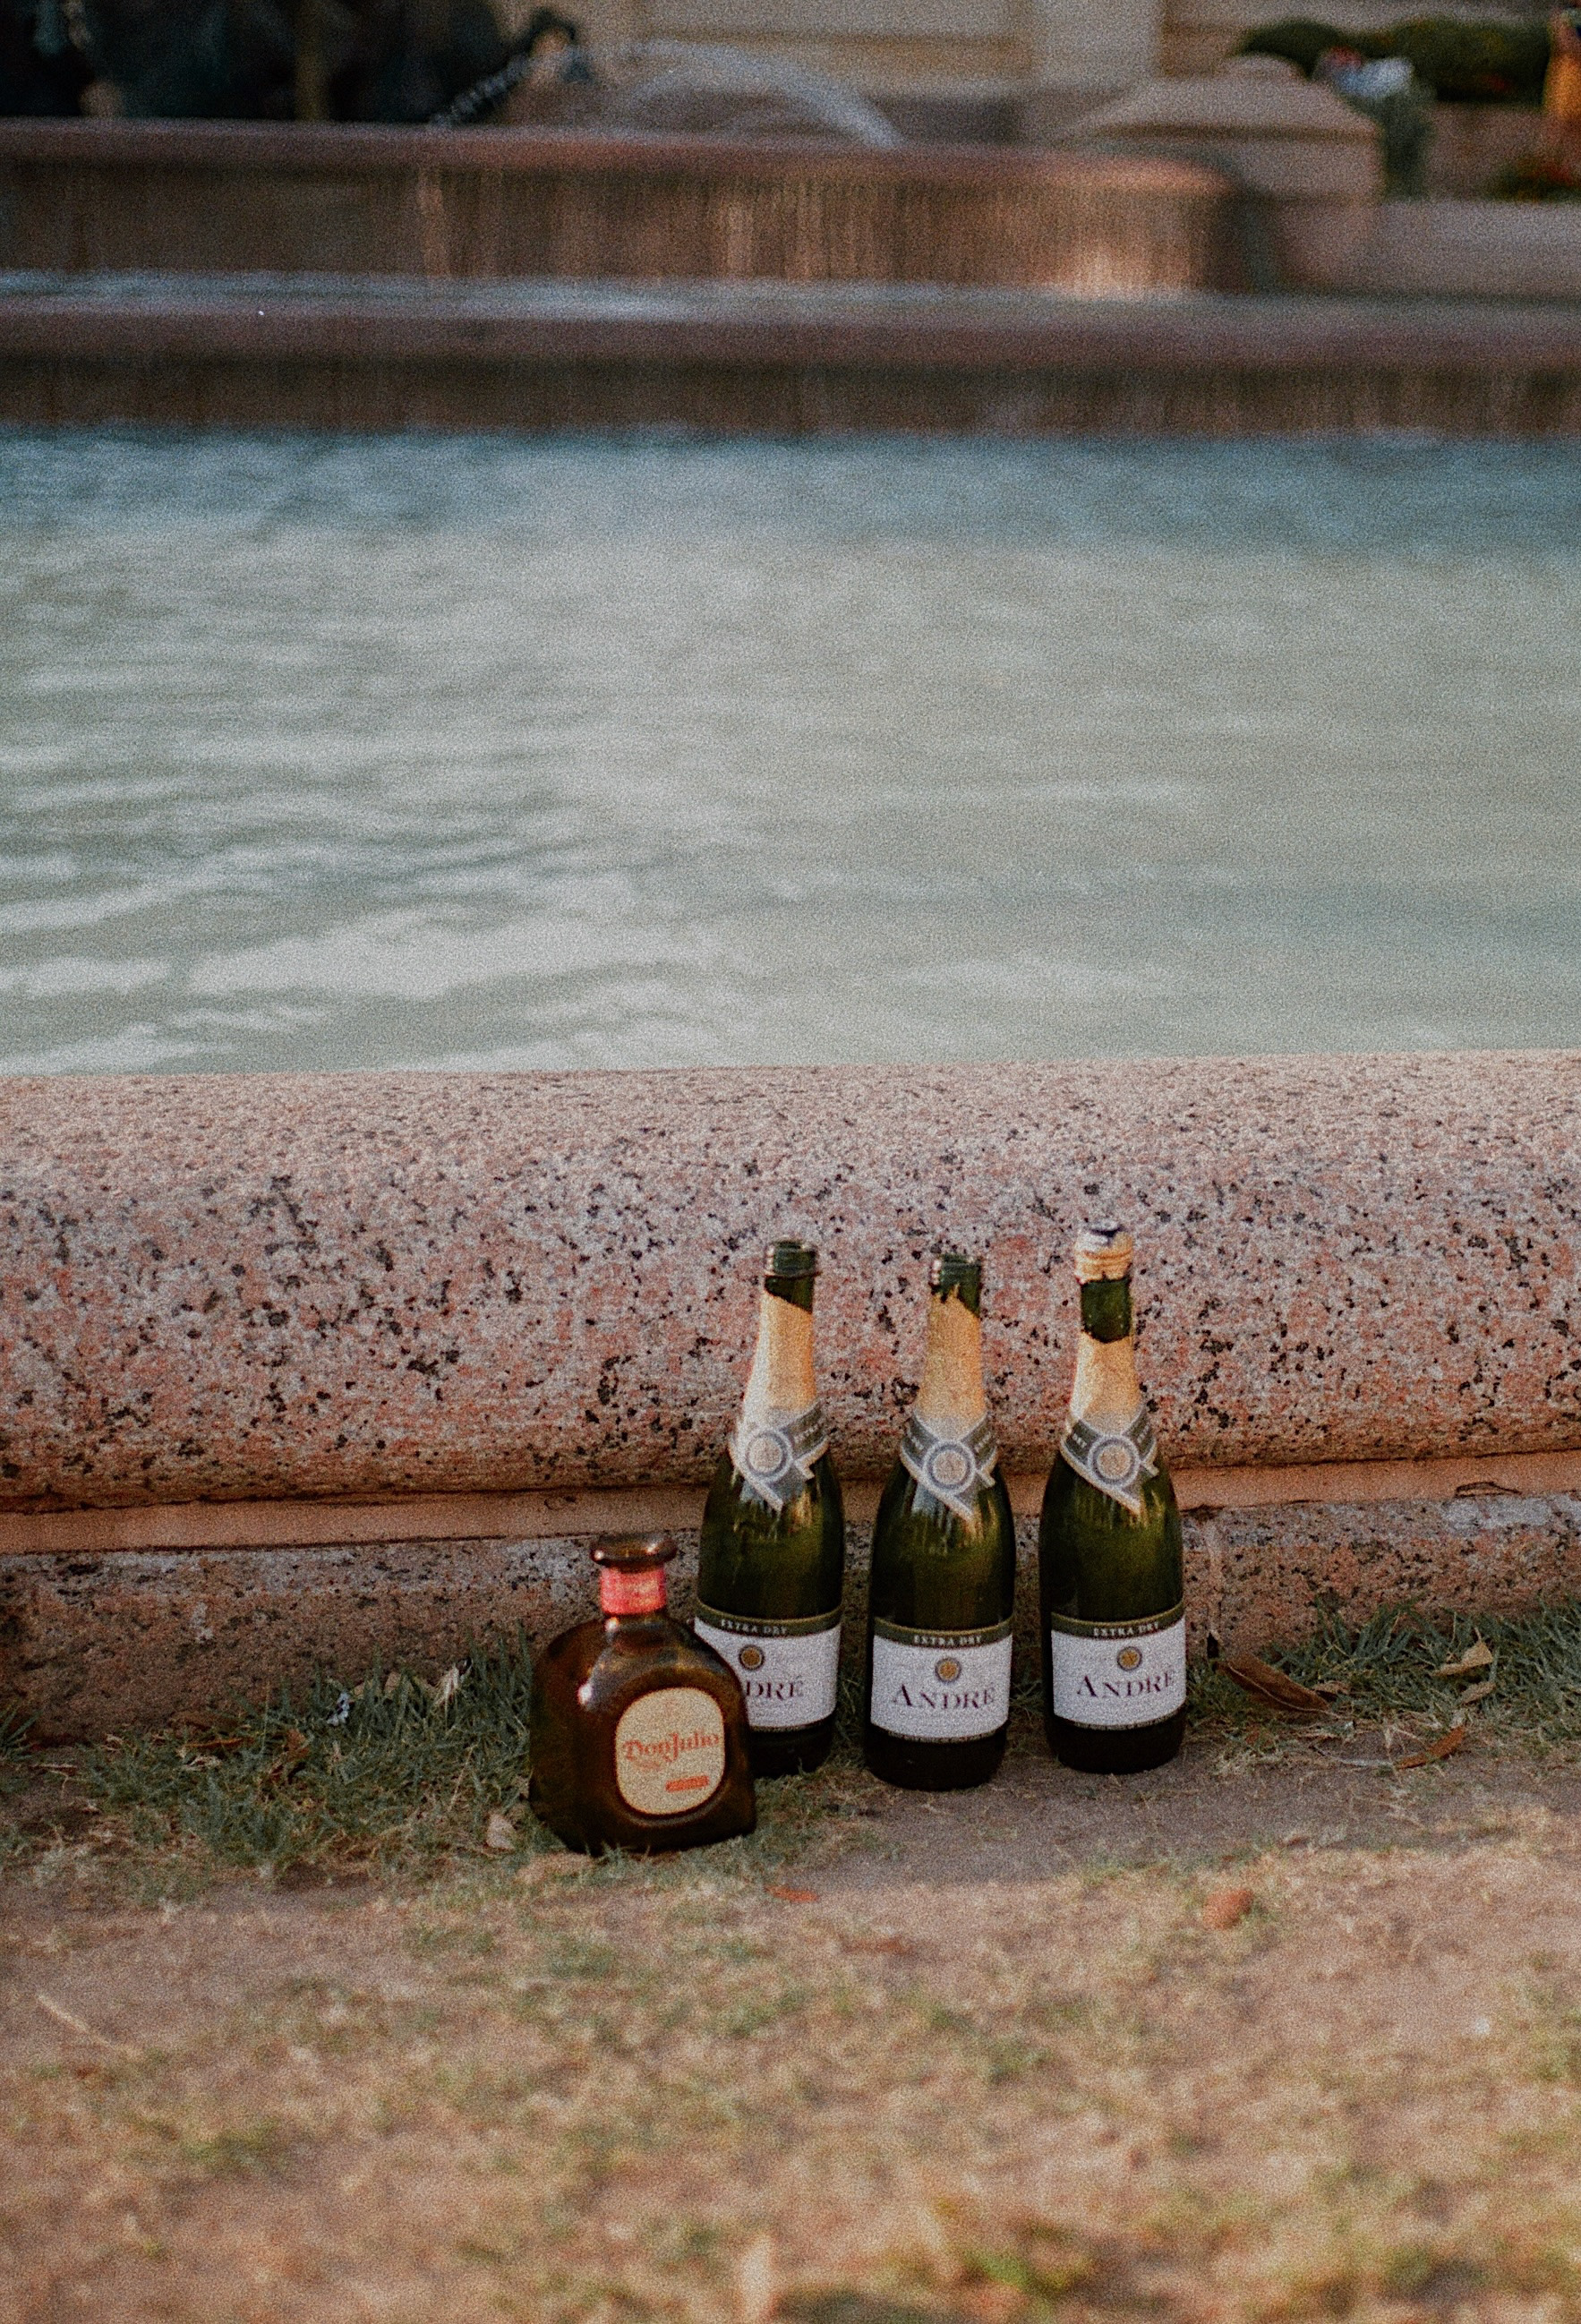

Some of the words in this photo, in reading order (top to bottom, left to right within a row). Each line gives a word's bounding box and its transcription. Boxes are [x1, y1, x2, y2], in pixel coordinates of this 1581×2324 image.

[721, 1619, 758, 1633] EXTRA
[764, 1626, 788, 1635] DRY
[1093, 1627, 1133, 1636] EXTRA
[914, 1635, 954, 1646] EXTRA
[746, 1675, 804, 1700] DRÉ
